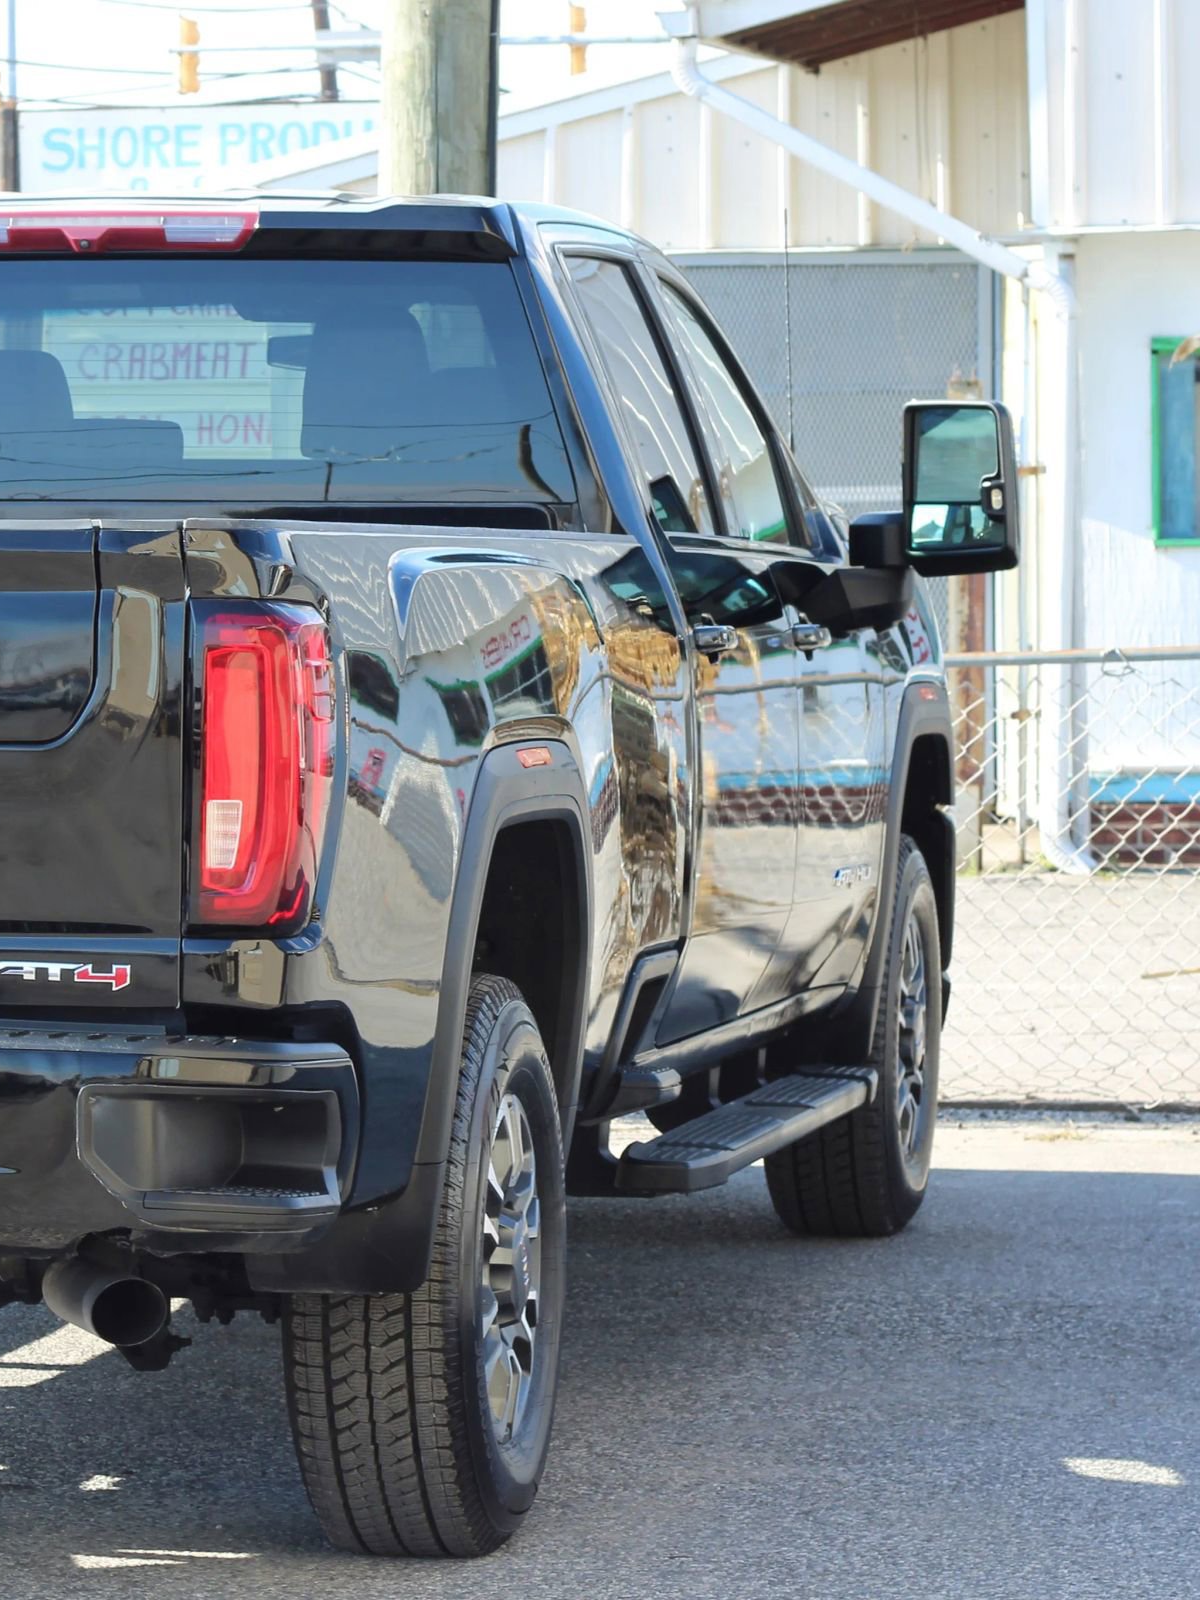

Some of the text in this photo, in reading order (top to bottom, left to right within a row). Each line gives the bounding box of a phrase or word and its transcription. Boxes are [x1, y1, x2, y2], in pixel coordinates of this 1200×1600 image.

[42, 124, 202, 172] SHORE
[77, 342, 257, 380] CRABMEAT
[197, 414, 272, 445] HON
